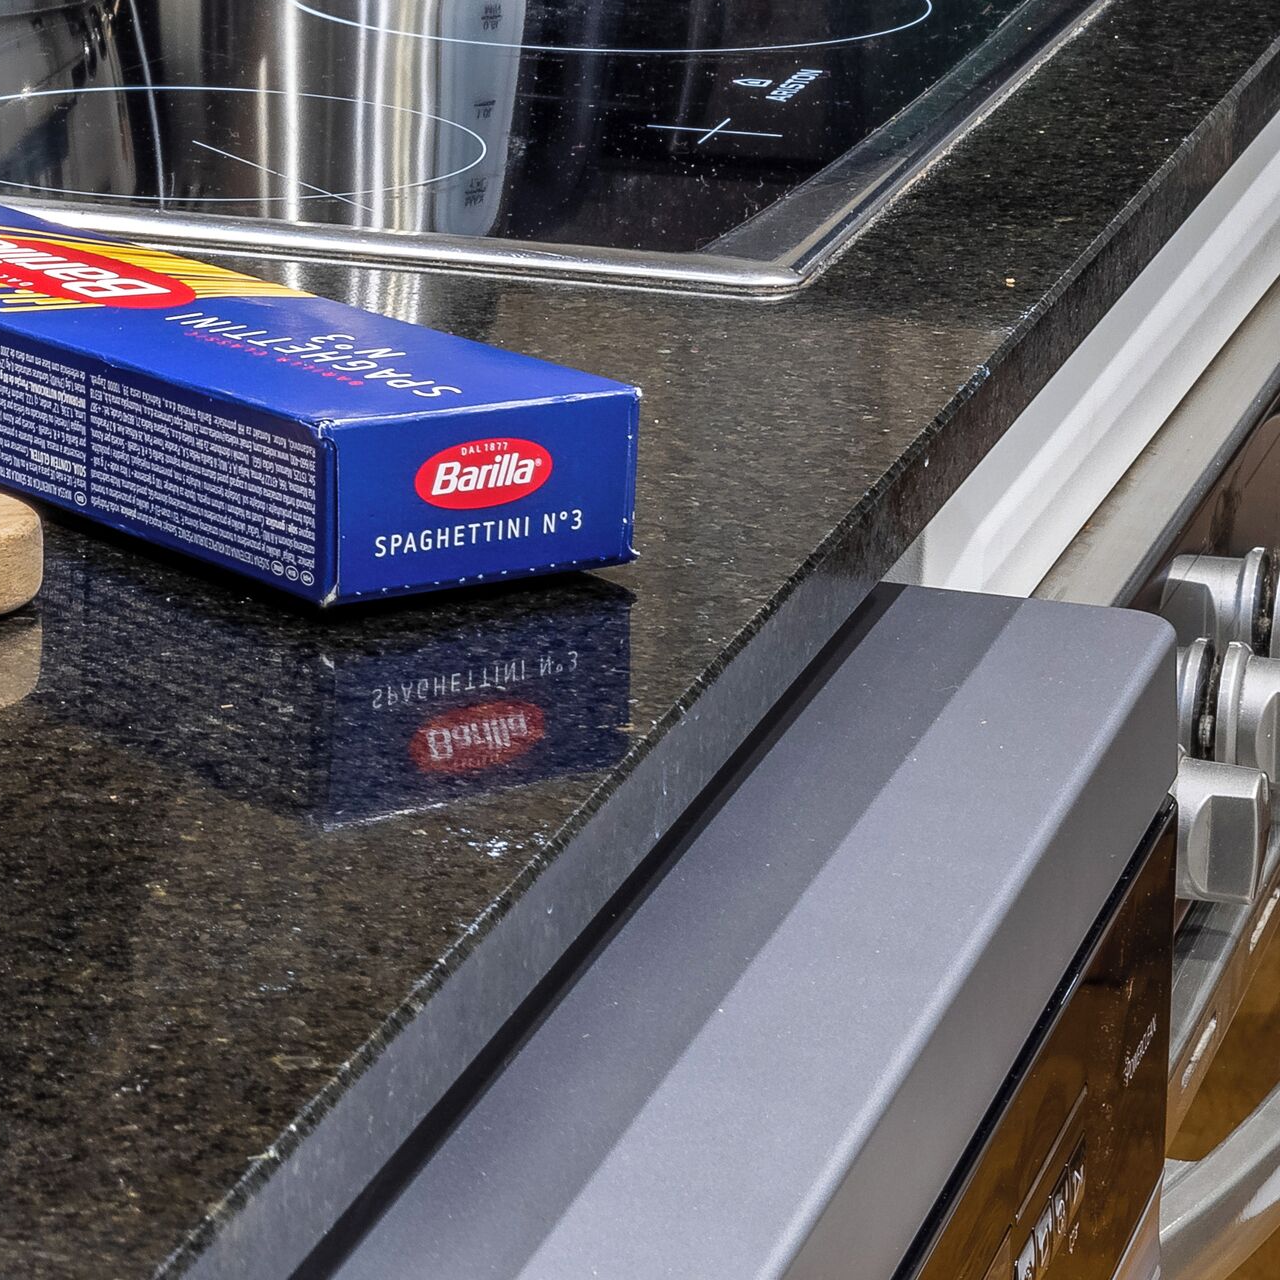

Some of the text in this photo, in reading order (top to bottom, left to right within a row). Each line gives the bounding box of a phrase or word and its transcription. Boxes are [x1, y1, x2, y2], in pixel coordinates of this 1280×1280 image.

[765, 68, 824, 102] ARISTON
[165, 312, 463, 398] SPAGHETTINI
[460, 441, 509, 456] DAL 1877
[431, 452, 535, 496] Barilla
[374, 508, 583, 557] SPAGHETTINI N°3
